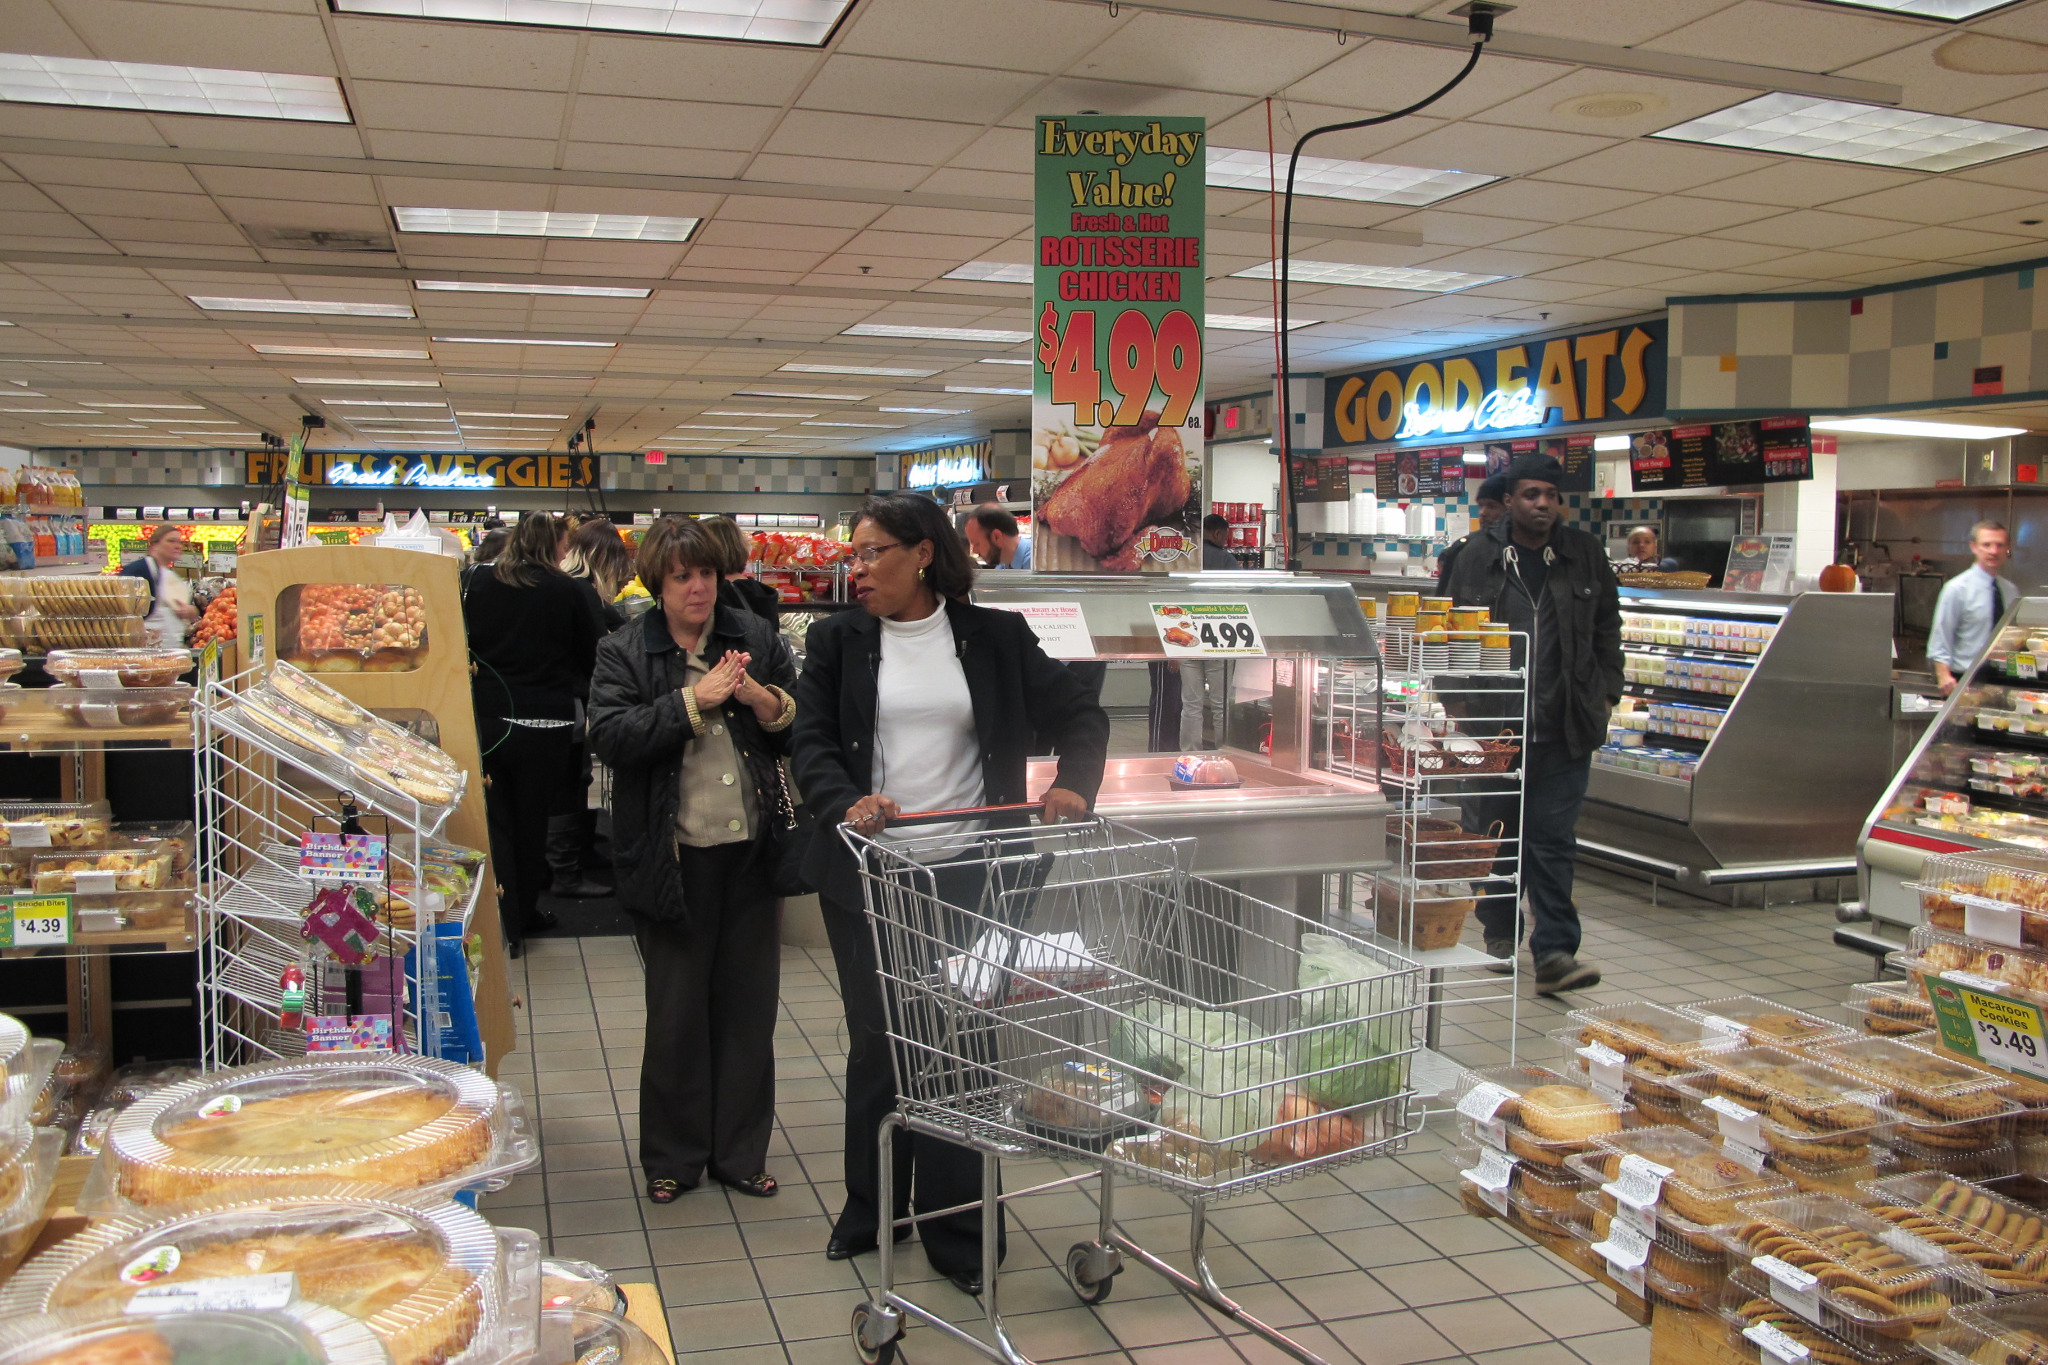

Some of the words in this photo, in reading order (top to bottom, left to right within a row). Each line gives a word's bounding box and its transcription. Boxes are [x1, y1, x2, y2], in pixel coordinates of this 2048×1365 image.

[1040, 119, 1202, 167] Everyday
[1067, 169, 1176, 208] Value!
[1071, 213, 1120, 232] Fresh
[1122, 216, 1137, 232] &
[1138, 213, 1169, 232] Hot
[1040, 236, 1199, 267] ROTISSERIE
[1058, 270, 1180, 301] CHICKEN
[1038, 301, 1201, 427] $4.99
[1188, 416, 1201, 428] ea.
[1335, 358, 1484, 443] GOOD
[1496, 327, 1654, 423] EATS
[248, 453, 379, 485] FRUITS
[420, 453, 593, 487] VEGGIES
[328, 463, 397, 485] Fresh
[1192, 621, 1255, 649] $4.99
[306, 843, 352, 853] Birthday
[306, 850, 343, 859] Banner
[21, 919, 61, 933] $4.39
[1970, 994, 2030, 1019] Macaroon
[1979, 1008, 2028, 1030] Cookies
[312, 1026, 359, 1035] Birthday
[312, 1034, 350, 1042] Banner
[1978, 1020, 2037, 1058] $3.49
